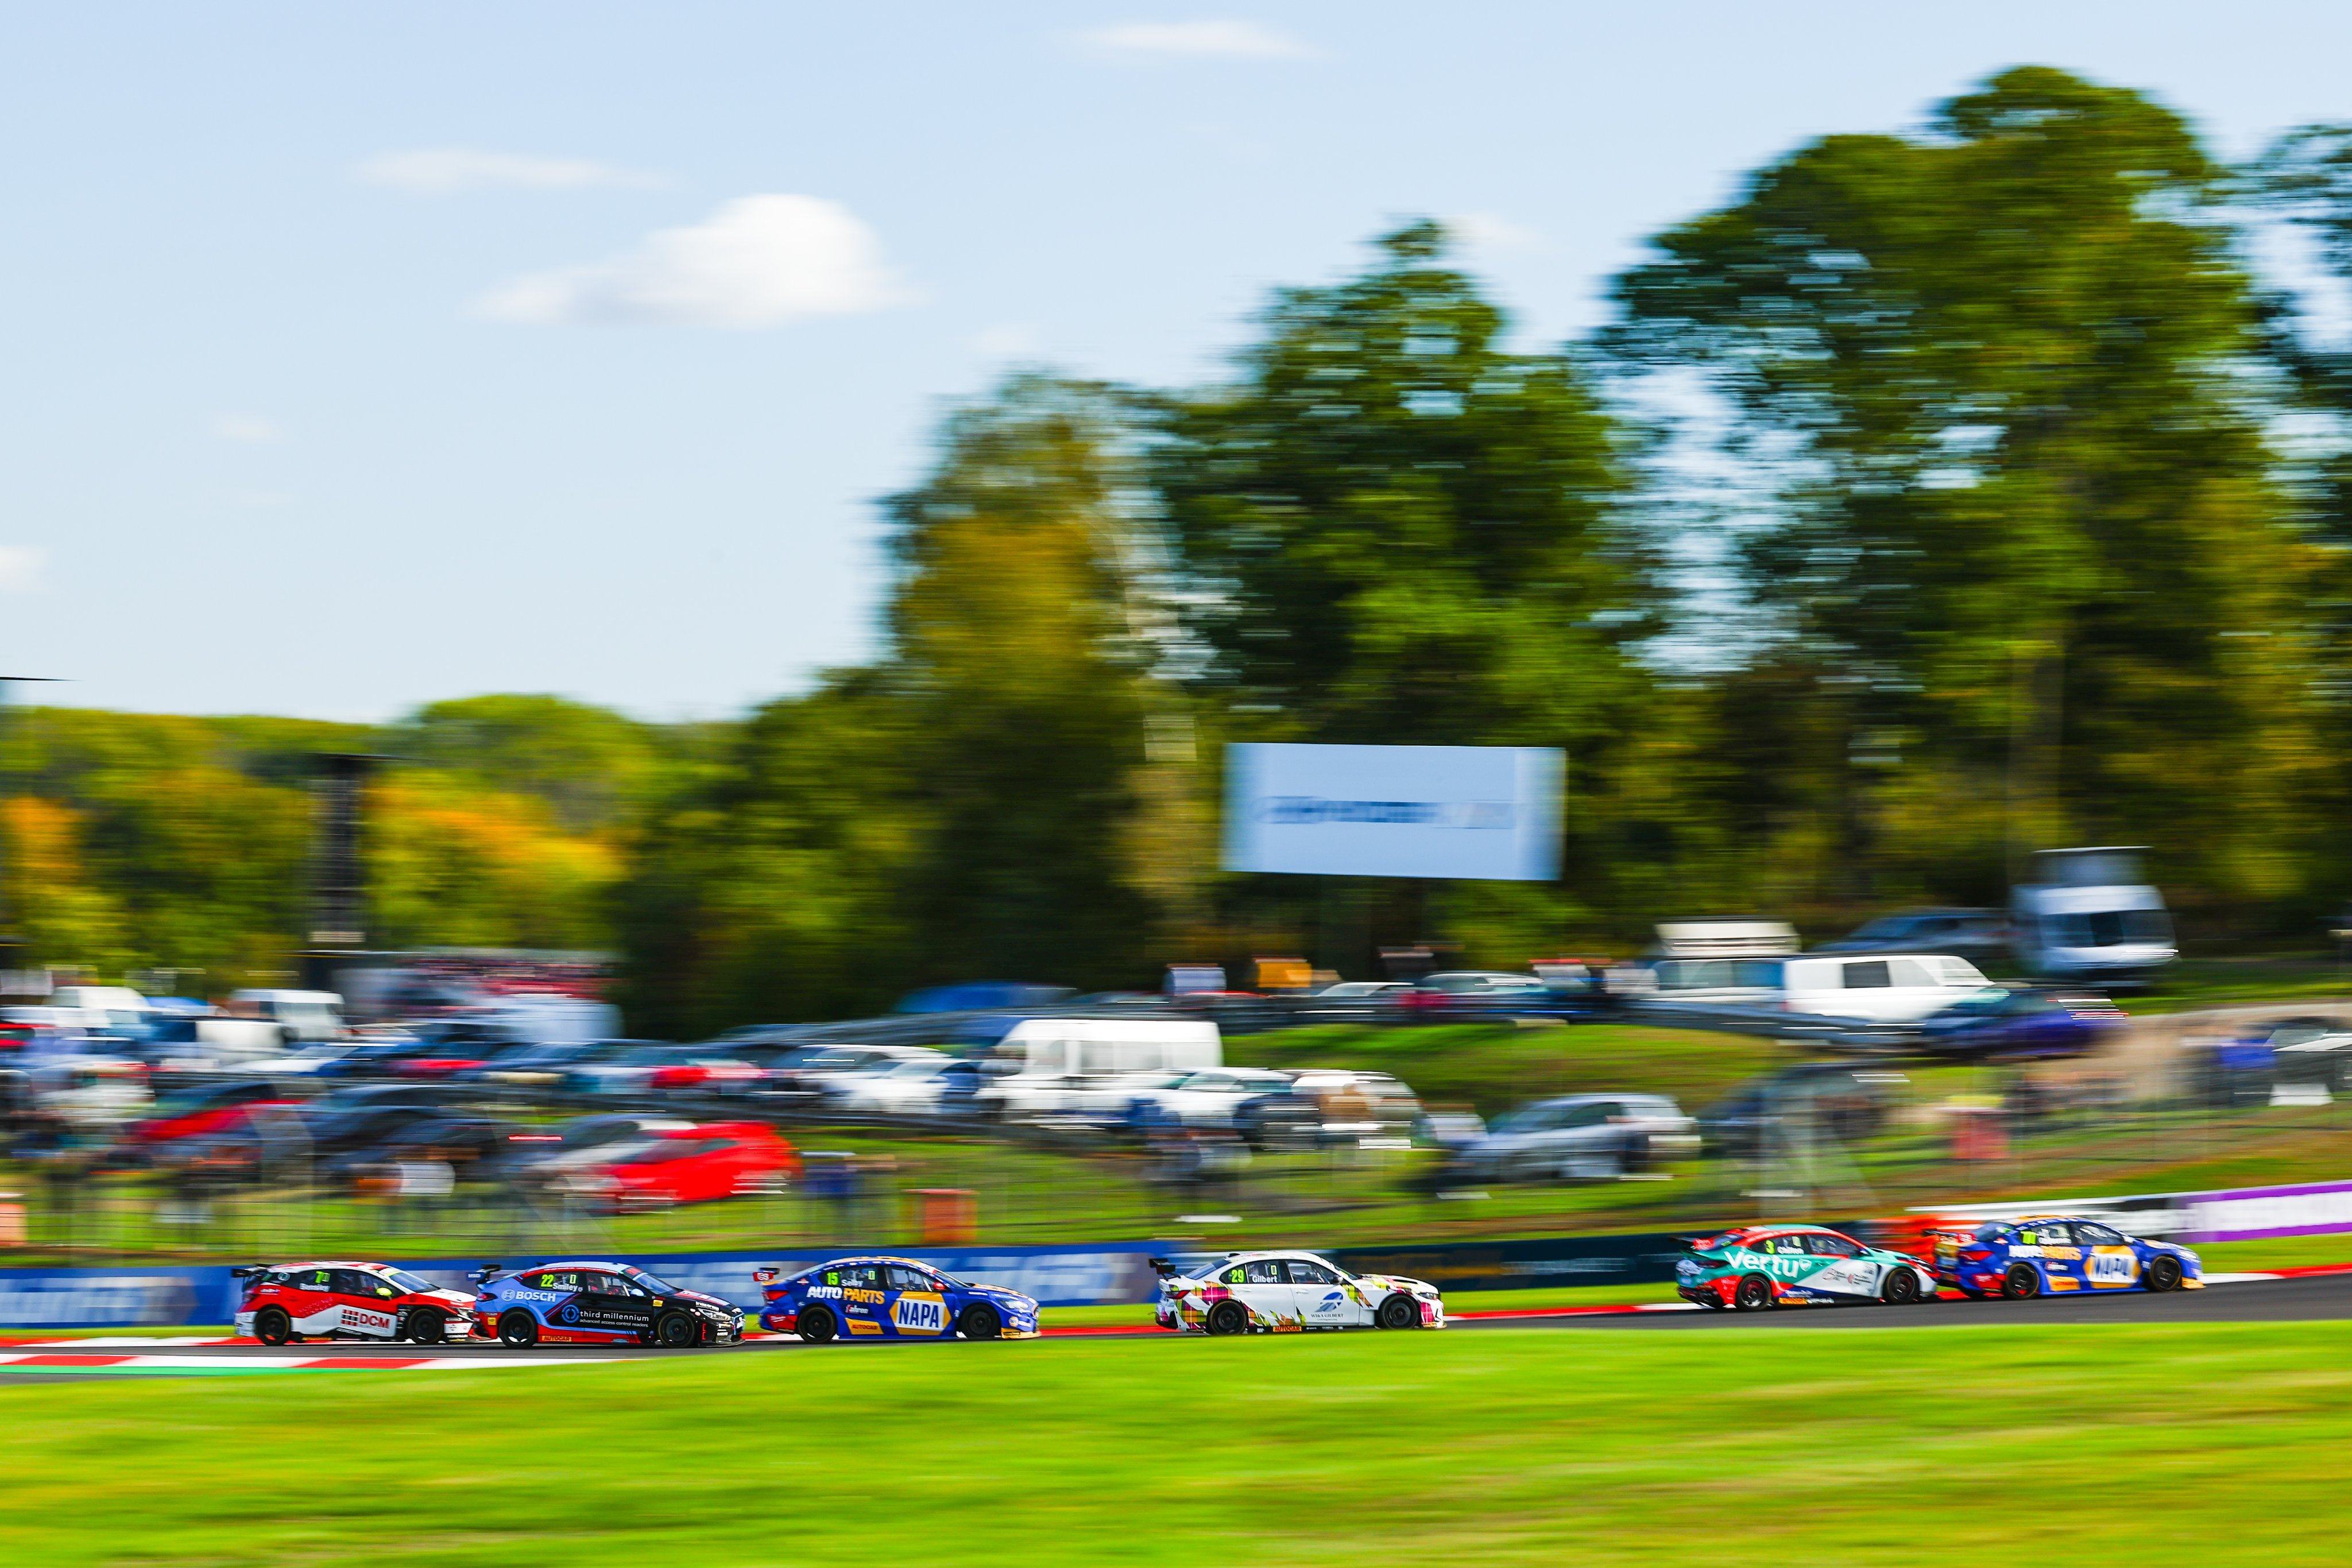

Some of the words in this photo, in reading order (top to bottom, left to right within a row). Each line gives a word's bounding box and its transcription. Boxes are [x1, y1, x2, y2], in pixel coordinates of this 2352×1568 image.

[1765, 1240, 1775, 1255] 3
[540, 1274, 555, 1287] 22
[827, 1272, 838, 1285] 15
[1231, 1269, 1245, 1283] 29
[1252, 1275, 1278, 1283] Gilbert
[552, 1282, 578, 1292] Smiley
[515, 1291, 556, 1303] BOSCH
[806, 1286, 842, 1299] AUTO
[842, 1288, 885, 1304] PARTS
[359, 1313, 390, 1329] DCM
[603, 1313, 649, 1322] millennium
[898, 1301, 939, 1328] NAPA
